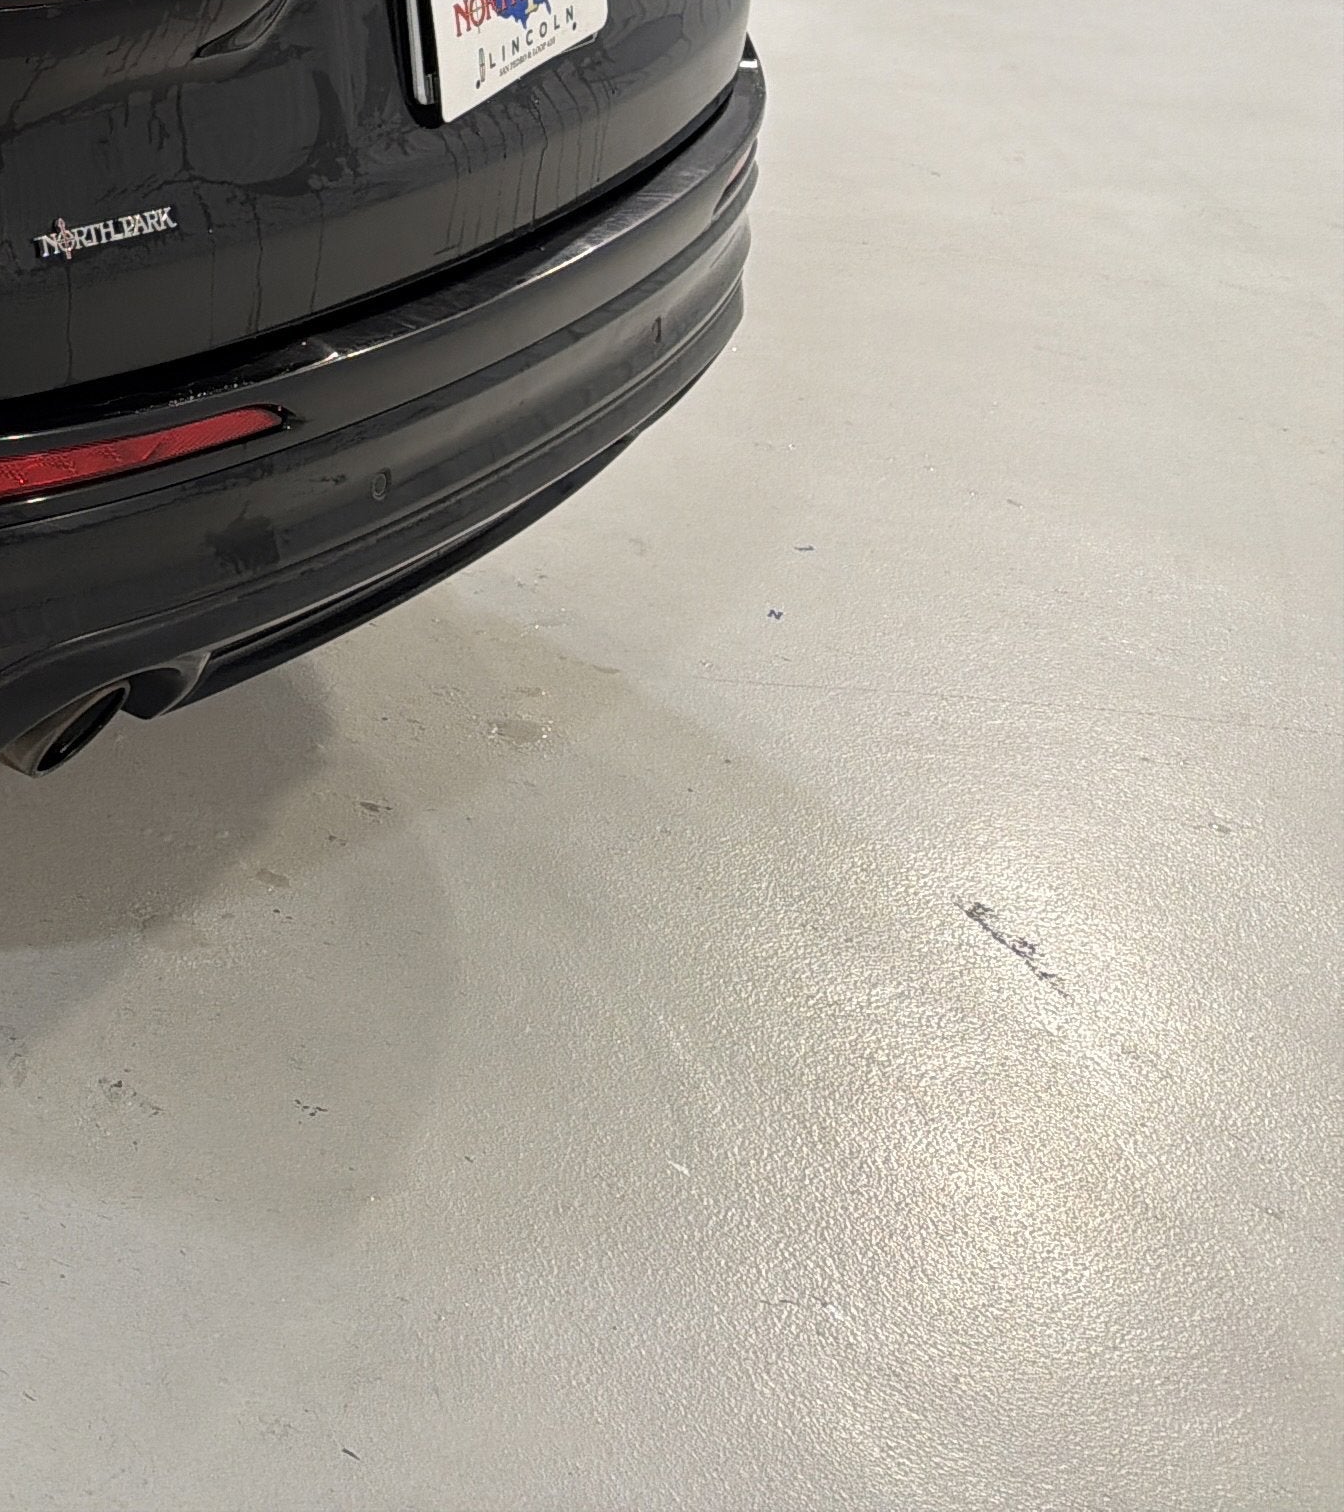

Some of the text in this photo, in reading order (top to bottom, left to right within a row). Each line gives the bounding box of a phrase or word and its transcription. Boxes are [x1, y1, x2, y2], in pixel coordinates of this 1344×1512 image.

[488, 4, 574, 70] LINCOLN
[33, 206, 178, 258] NORTH PARK
